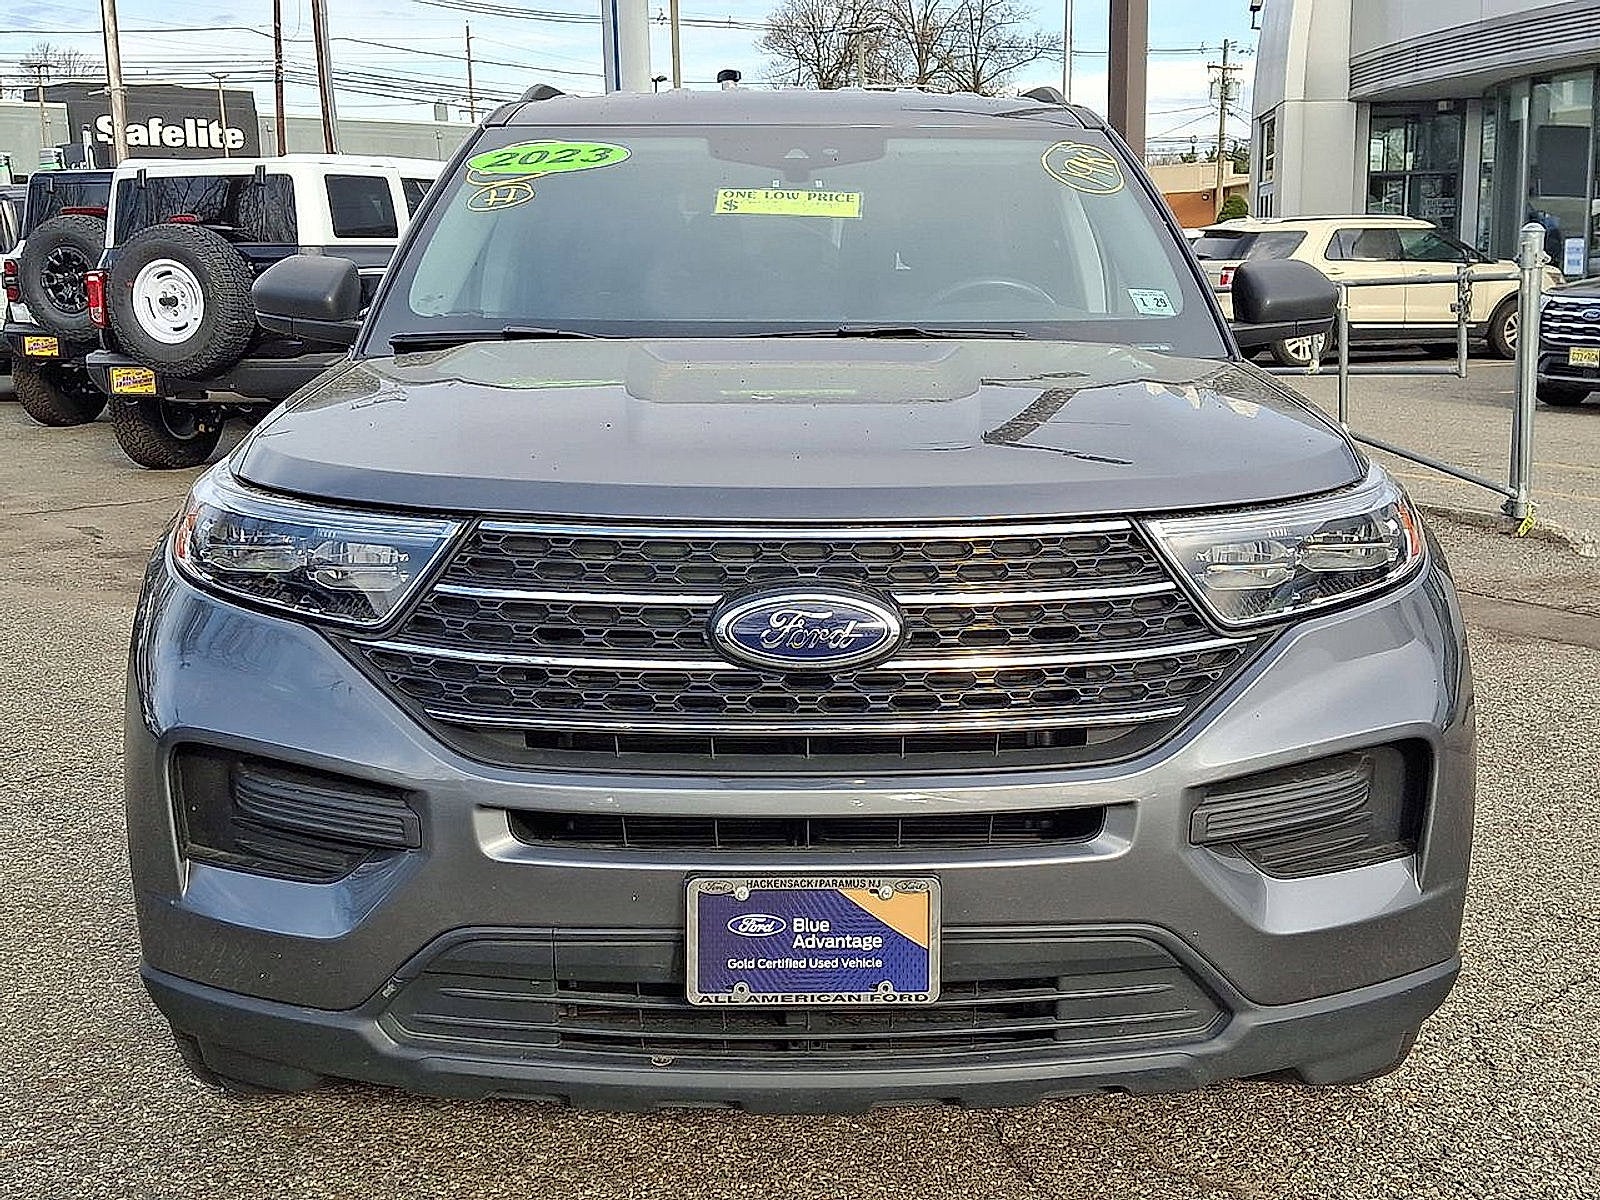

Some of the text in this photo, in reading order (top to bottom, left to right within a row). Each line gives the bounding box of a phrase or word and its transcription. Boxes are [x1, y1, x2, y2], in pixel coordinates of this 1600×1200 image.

[95, 114, 245, 149] Safelite
[482, 147, 614, 168] 2023
[722, 199, 738, 211] $
[723, 191, 855, 203] ONE LOW PRICE
[760, 609, 858, 649] Ford
[746, 879, 881, 889] HACKENSACK/PARAMUS NJ
[738, 916, 776, 933] Ford
[792, 917, 830, 933] Blue
[792, 934, 883, 951] Advantage
[727, 957, 883, 969] Gold Certified Used Vehicle
[699, 993, 930, 1004] ALL AMERICAN FORD
